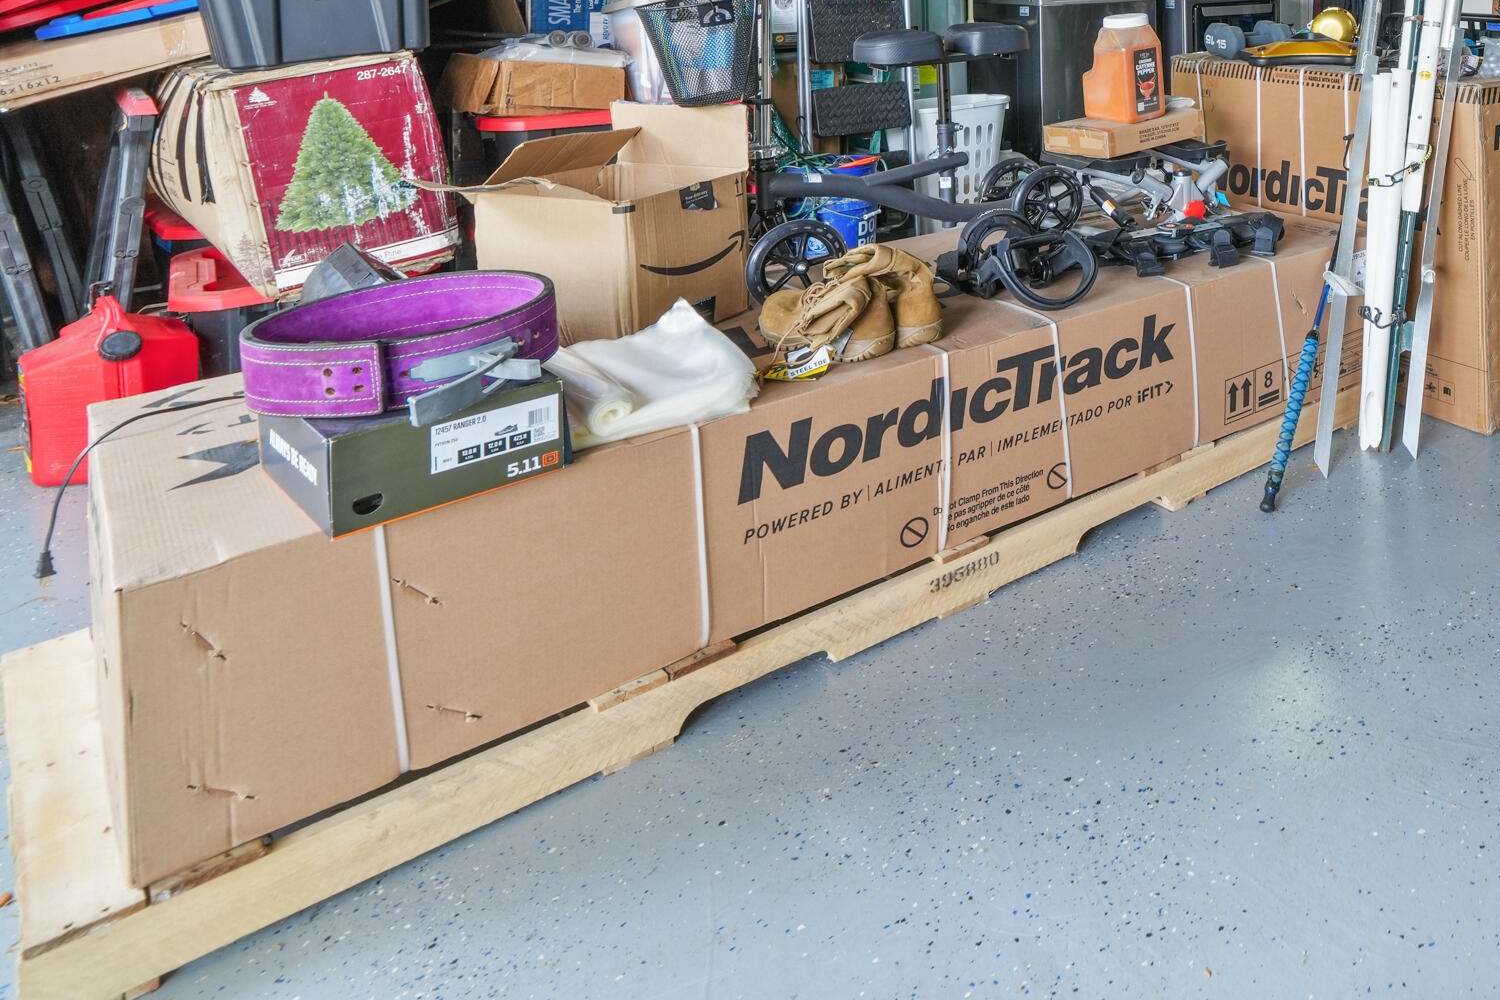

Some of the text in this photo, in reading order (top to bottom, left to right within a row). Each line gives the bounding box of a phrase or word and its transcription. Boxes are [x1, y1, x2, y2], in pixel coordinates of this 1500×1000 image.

[1216, 39, 1227, 49] 15
[357, 64, 407, 80] 287-2647
[1137, 68, 1155, 76] PEPPER
[1464, 204, 1468, 212] DE
[858, 217, 875, 236] DO
[790, 363, 812, 377] STEEL
[813, 358, 827, 368] TOE
[1264, 371, 1273, 388] 8
[737, 314, 1176, 506] NordicTrack
[453, 418, 476, 430] RANGER
[477, 416, 487, 424] 2.0
[507, 456, 541, 478] 5.11
[744, 500, 833, 545] POWERED
[840, 489, 863, 510] BY
[874, 457, 952, 497] ALIMENT
[958, 446, 986, 467] PAR
[1107, 395, 1132, 414] POR
[958, 493, 980, 506] Clamp
[981, 486, 999, 498] From
[1000, 480, 1014, 490] This
[1015, 469, 1044, 485] Direction
[954, 508, 966, 521] pas
[967, 498, 996, 515] agripper
[998, 493, 1006, 502] de
[1016, 482, 1029, 495] côté
[955, 512, 990, 529] enganche
[990, 506, 999, 516] de
[1001, 502, 1014, 512] este
[1016, 495, 1030, 506] lado
